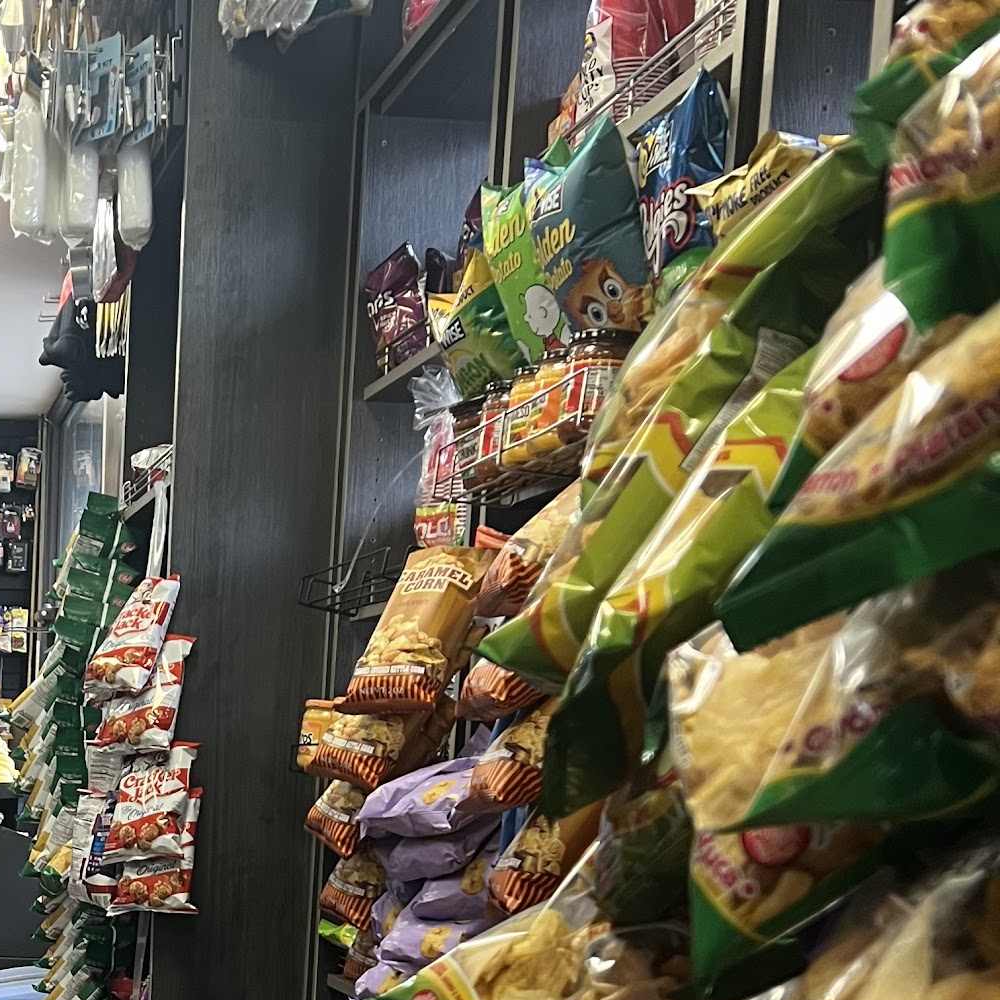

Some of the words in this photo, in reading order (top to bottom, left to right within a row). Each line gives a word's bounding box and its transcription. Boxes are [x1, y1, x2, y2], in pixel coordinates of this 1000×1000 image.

[750, 164, 771, 191] FREE
[751, 171, 791, 206] PRODUCT
[441, 318, 465, 349] WISE
[398, 566, 473, 586] CARAMEL
[404, 578, 446, 592] CORN
[136, 860, 177, 876] Original
